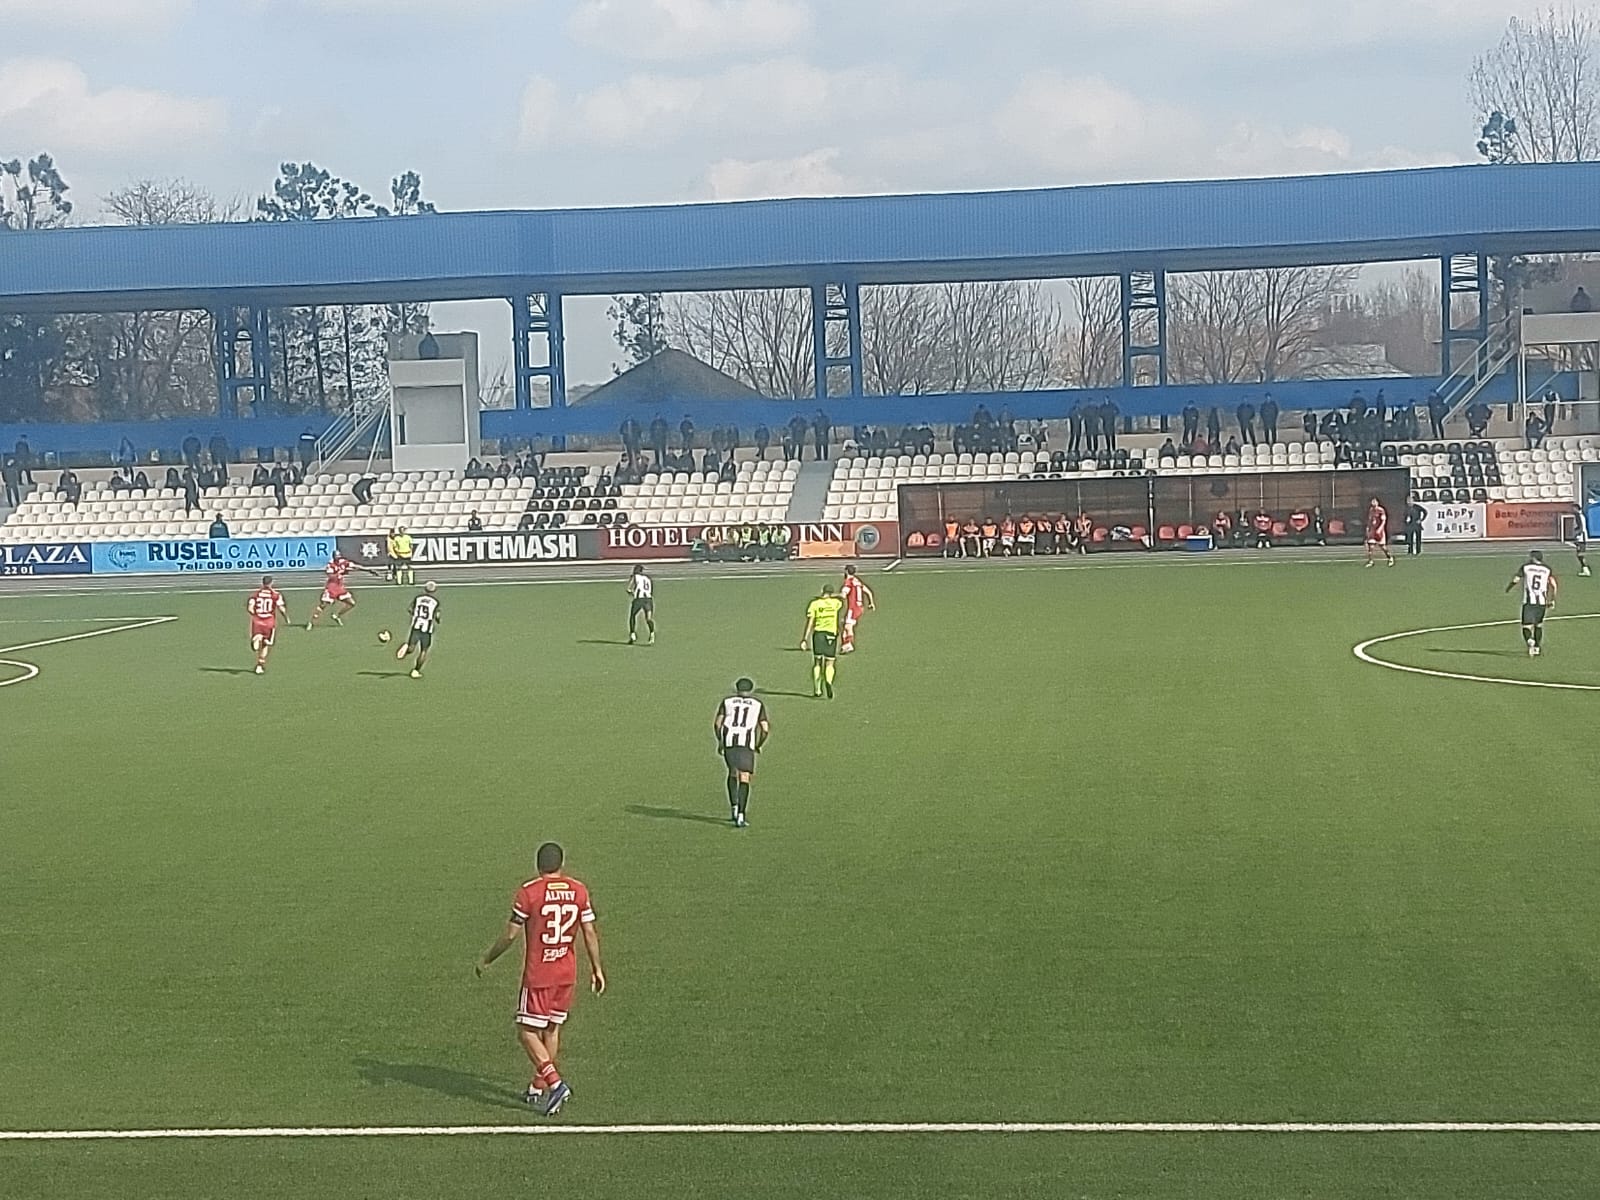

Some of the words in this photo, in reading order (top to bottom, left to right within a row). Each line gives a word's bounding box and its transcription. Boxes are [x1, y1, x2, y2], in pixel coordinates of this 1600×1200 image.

[608, 527, 694, 547] HOTEL
[800, 524, 843, 542] INN
[0, 545, 88, 565] LAZA
[149, 542, 222, 561] RUSEL
[228, 542, 328, 559] CAVIAR
[411, 534, 577, 561] ZNEFTEMASH
[4, 566, 18, 575] 22
[1532, 574, 1541, 590] 6
[256, 597, 273, 613] 30
[417, 605, 430, 620] 19
[732, 706, 750, 727] 11
[541, 903, 579, 945] 32
